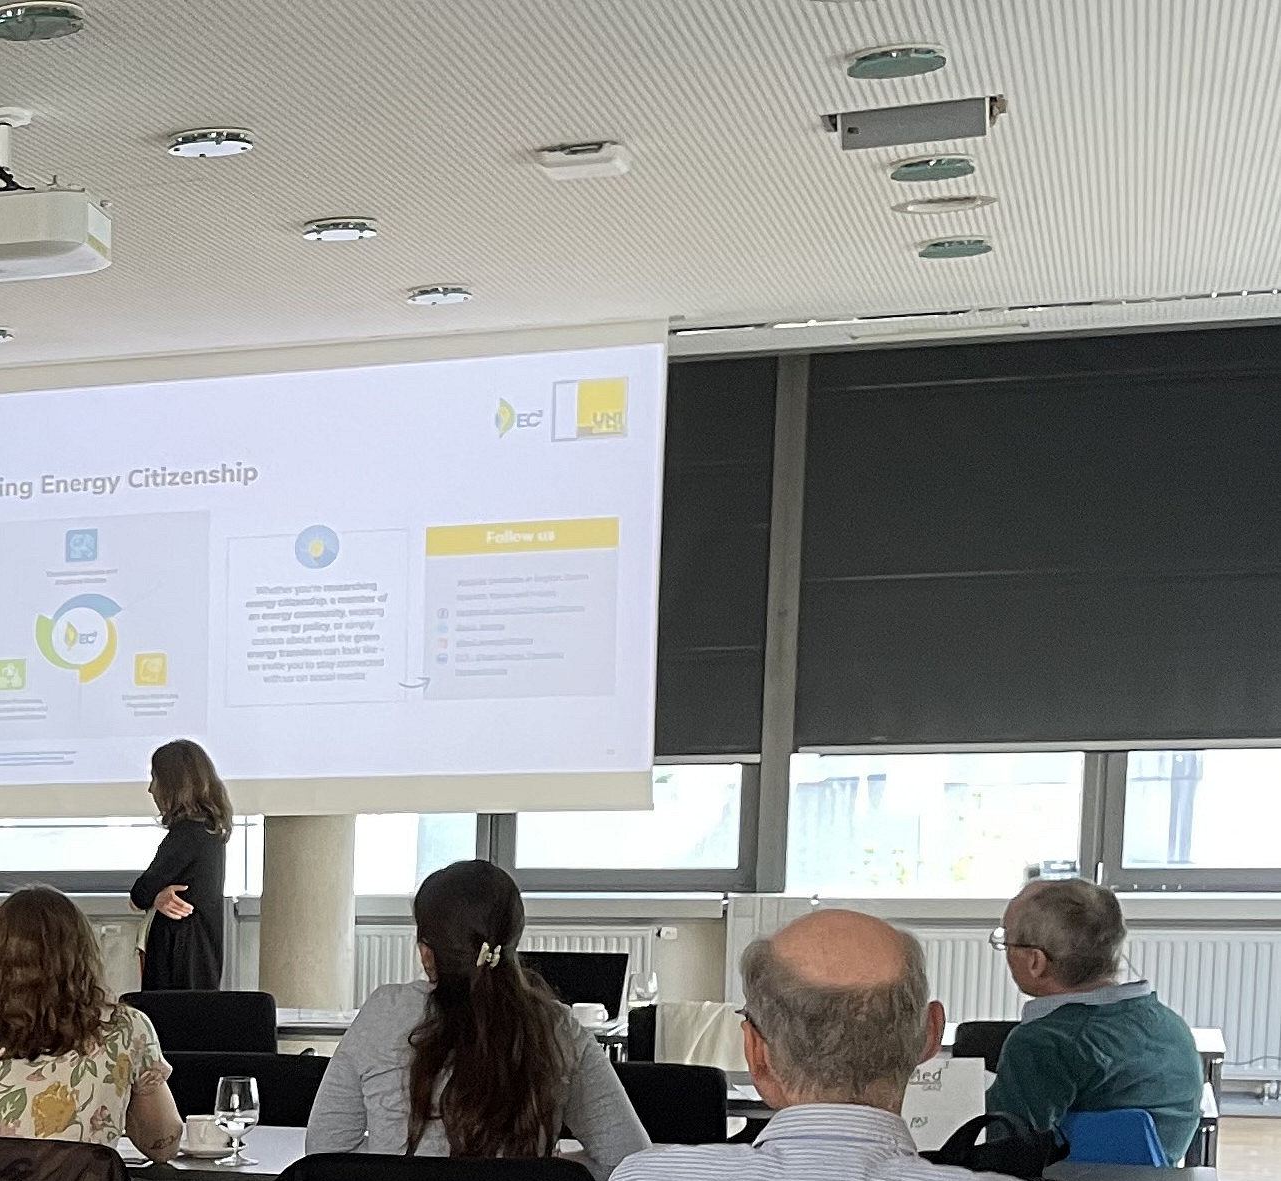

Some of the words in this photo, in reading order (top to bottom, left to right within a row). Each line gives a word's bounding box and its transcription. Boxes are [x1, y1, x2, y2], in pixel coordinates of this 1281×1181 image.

[41, 474, 121, 495] Energy
[128, 461, 259, 488] Citizenship
[486, 529, 535, 545] Follow
[538, 529, 557, 542] us
